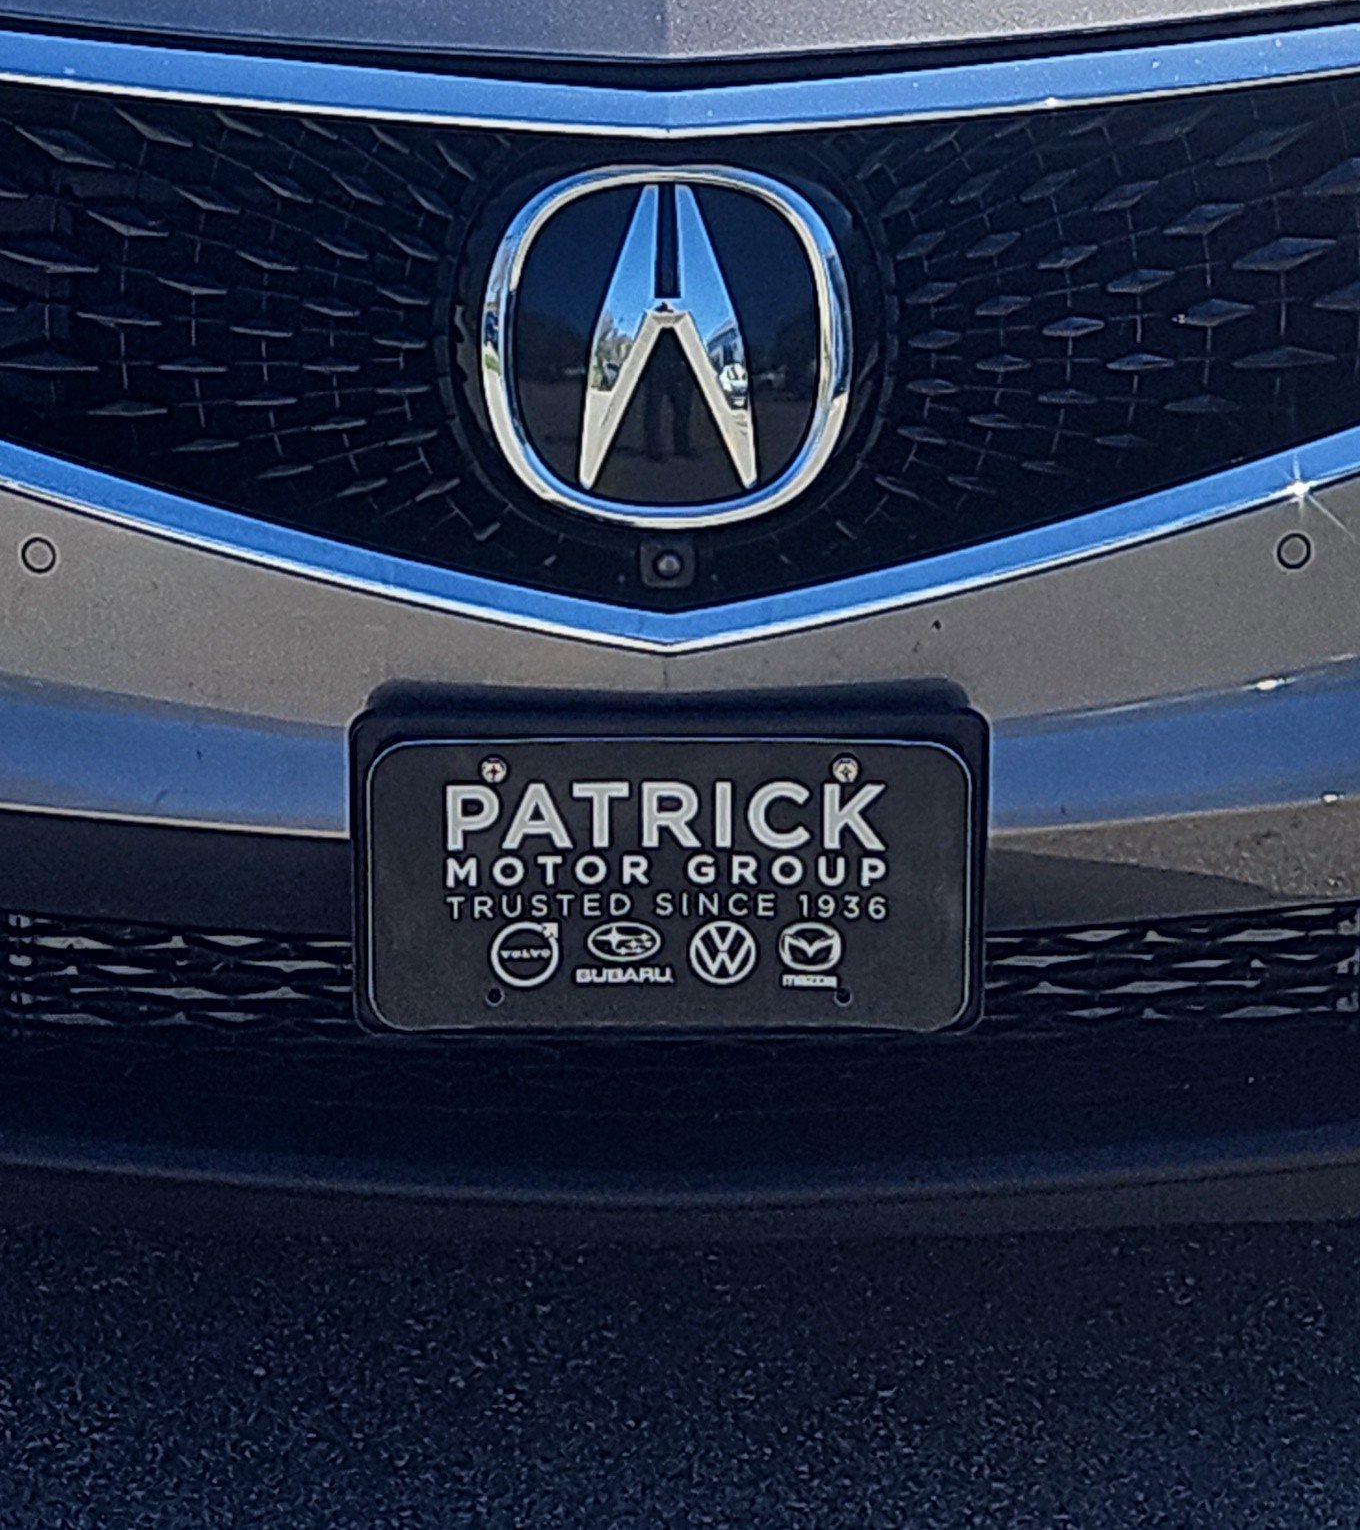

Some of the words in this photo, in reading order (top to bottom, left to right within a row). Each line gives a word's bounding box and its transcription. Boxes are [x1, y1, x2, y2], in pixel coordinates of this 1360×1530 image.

[445, 781, 886, 851] PATRICK
[445, 854, 650, 888] MOTOR
[687, 854, 887, 887] GROUP
[446, 892, 632, 920] TRUSTED
[655, 892, 776, 916] SINCE
[798, 894, 887, 920] 1936
[499, 947, 552, 960] VOLVO
[575, 966, 672, 984] SUBARU
